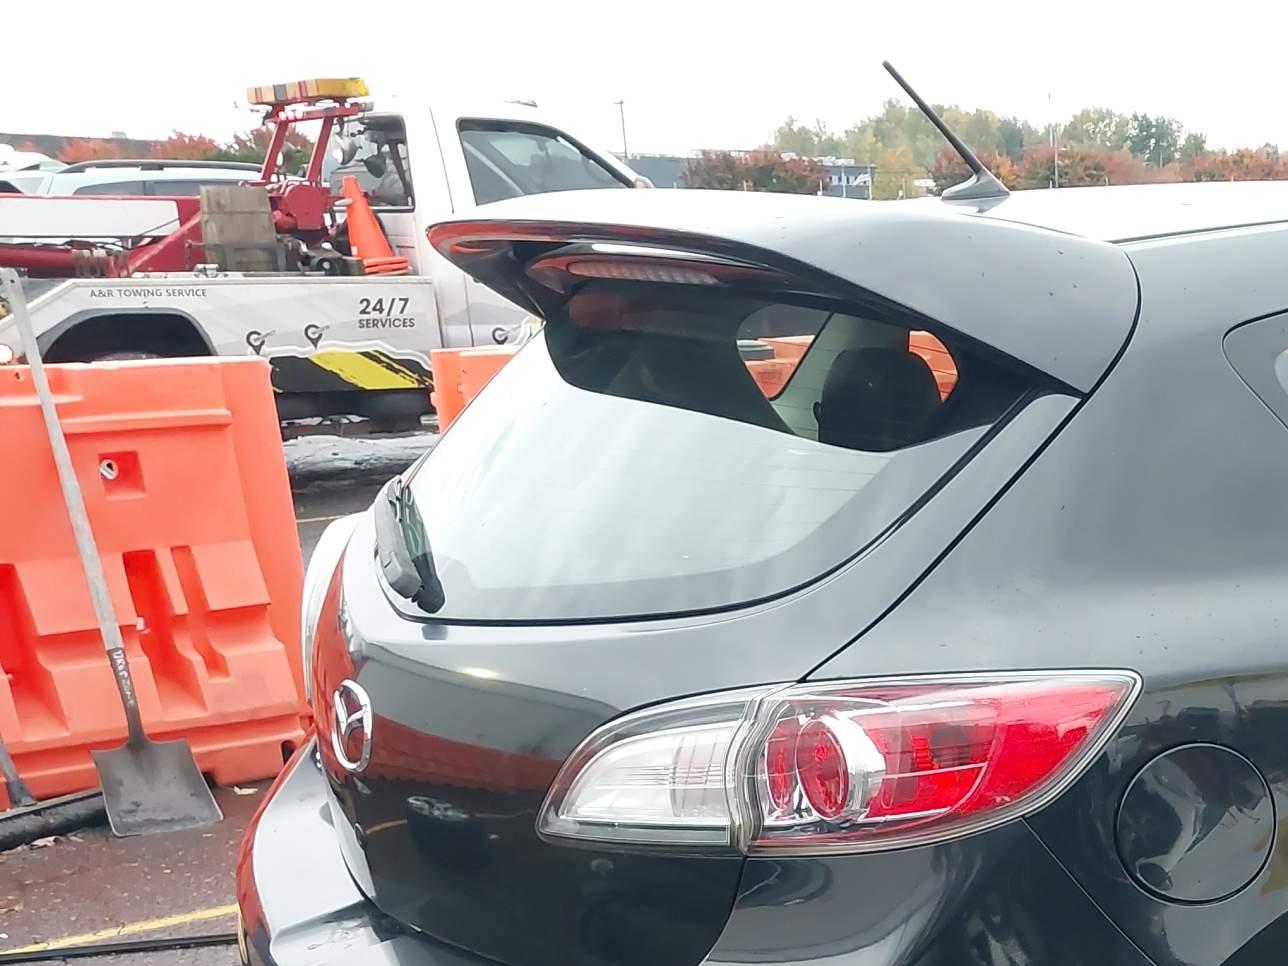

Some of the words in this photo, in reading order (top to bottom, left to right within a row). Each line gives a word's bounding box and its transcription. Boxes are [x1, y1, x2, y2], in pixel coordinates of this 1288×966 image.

[90, 288, 114, 298] A&R
[116, 288, 163, 298] TOWING
[165, 288, 208, 298] SERVICE
[359, 297, 410, 317] 24/7
[358, 317, 416, 329] SERVICES
